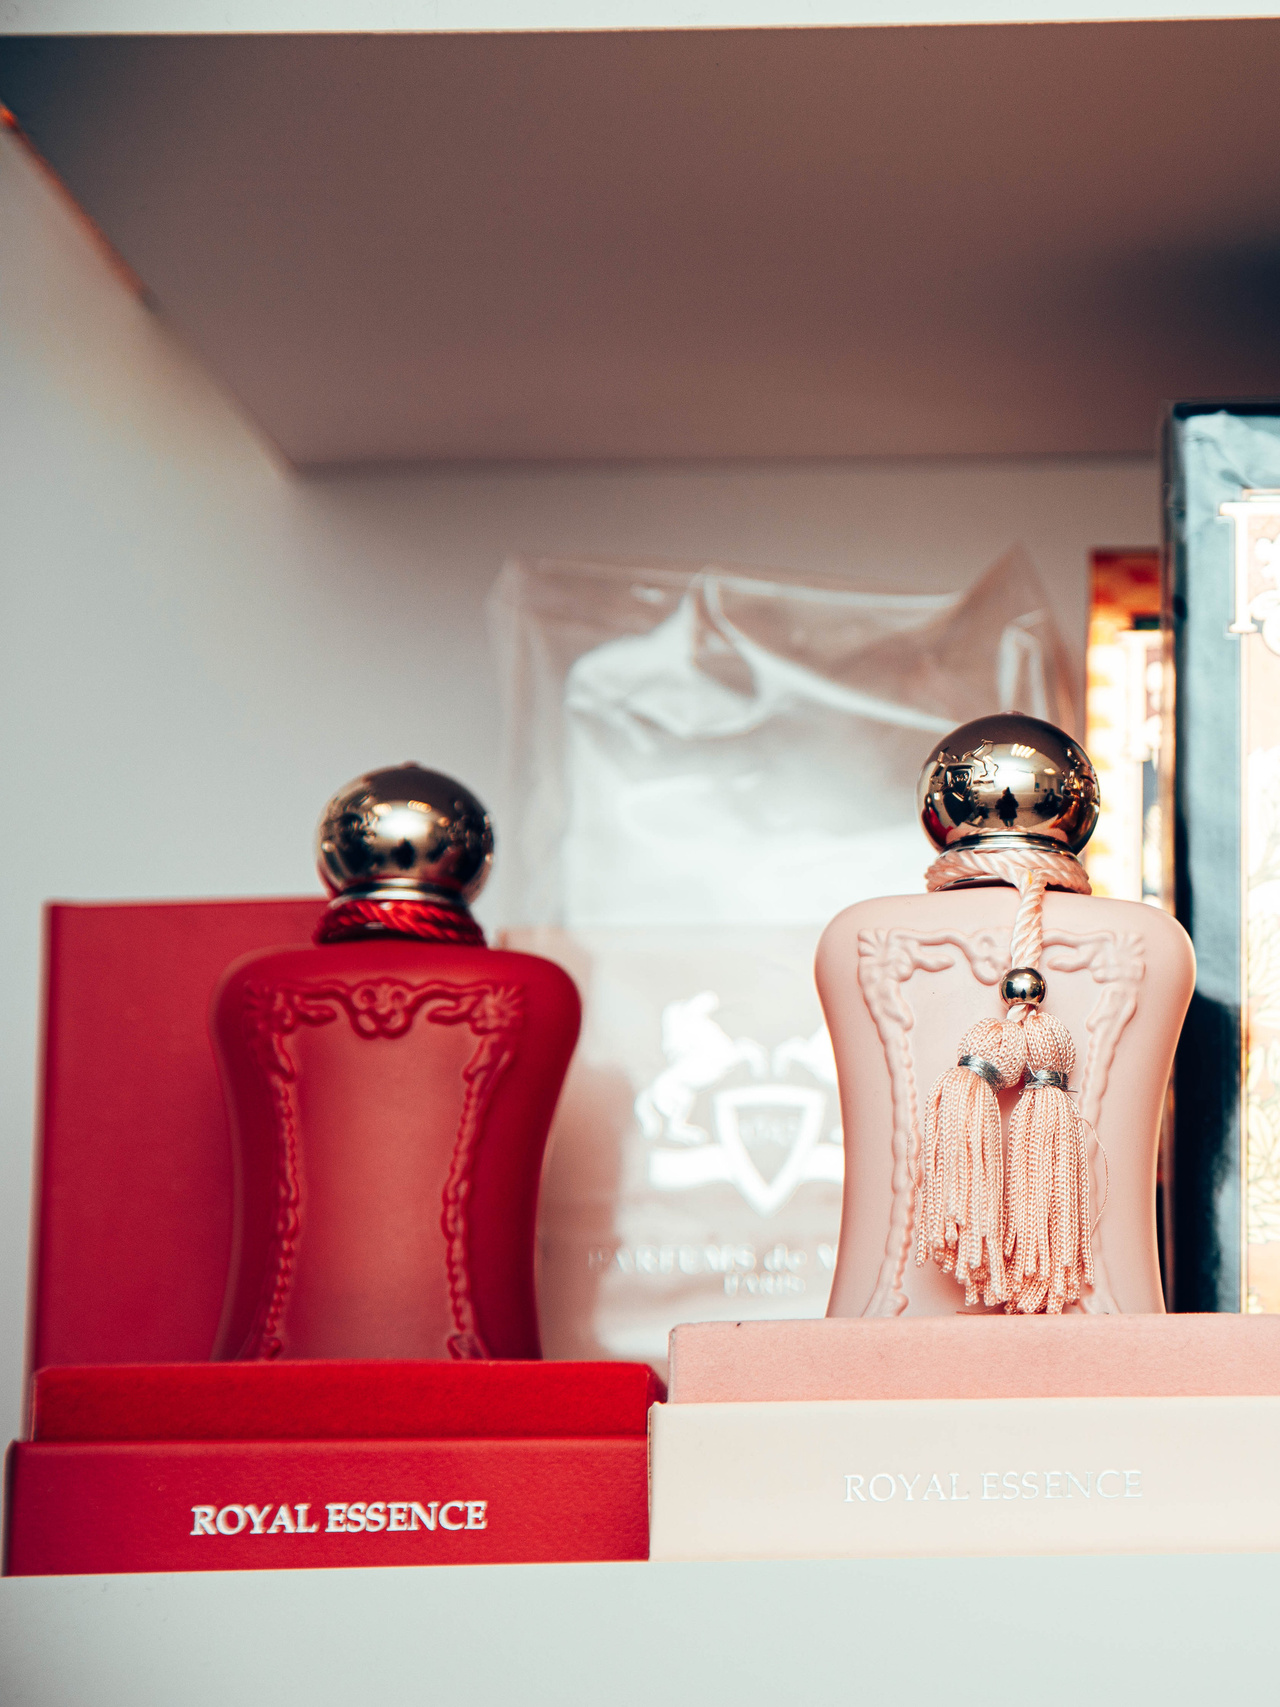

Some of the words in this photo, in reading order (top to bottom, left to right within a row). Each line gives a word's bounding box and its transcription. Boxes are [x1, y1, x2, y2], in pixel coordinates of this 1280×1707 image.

[843, 1471, 971, 1504] ROYAL
[980, 1469, 1145, 1501] ESSENCE
[190, 1502, 319, 1536] ROYAL
[325, 1500, 489, 1534] ESSENCE
